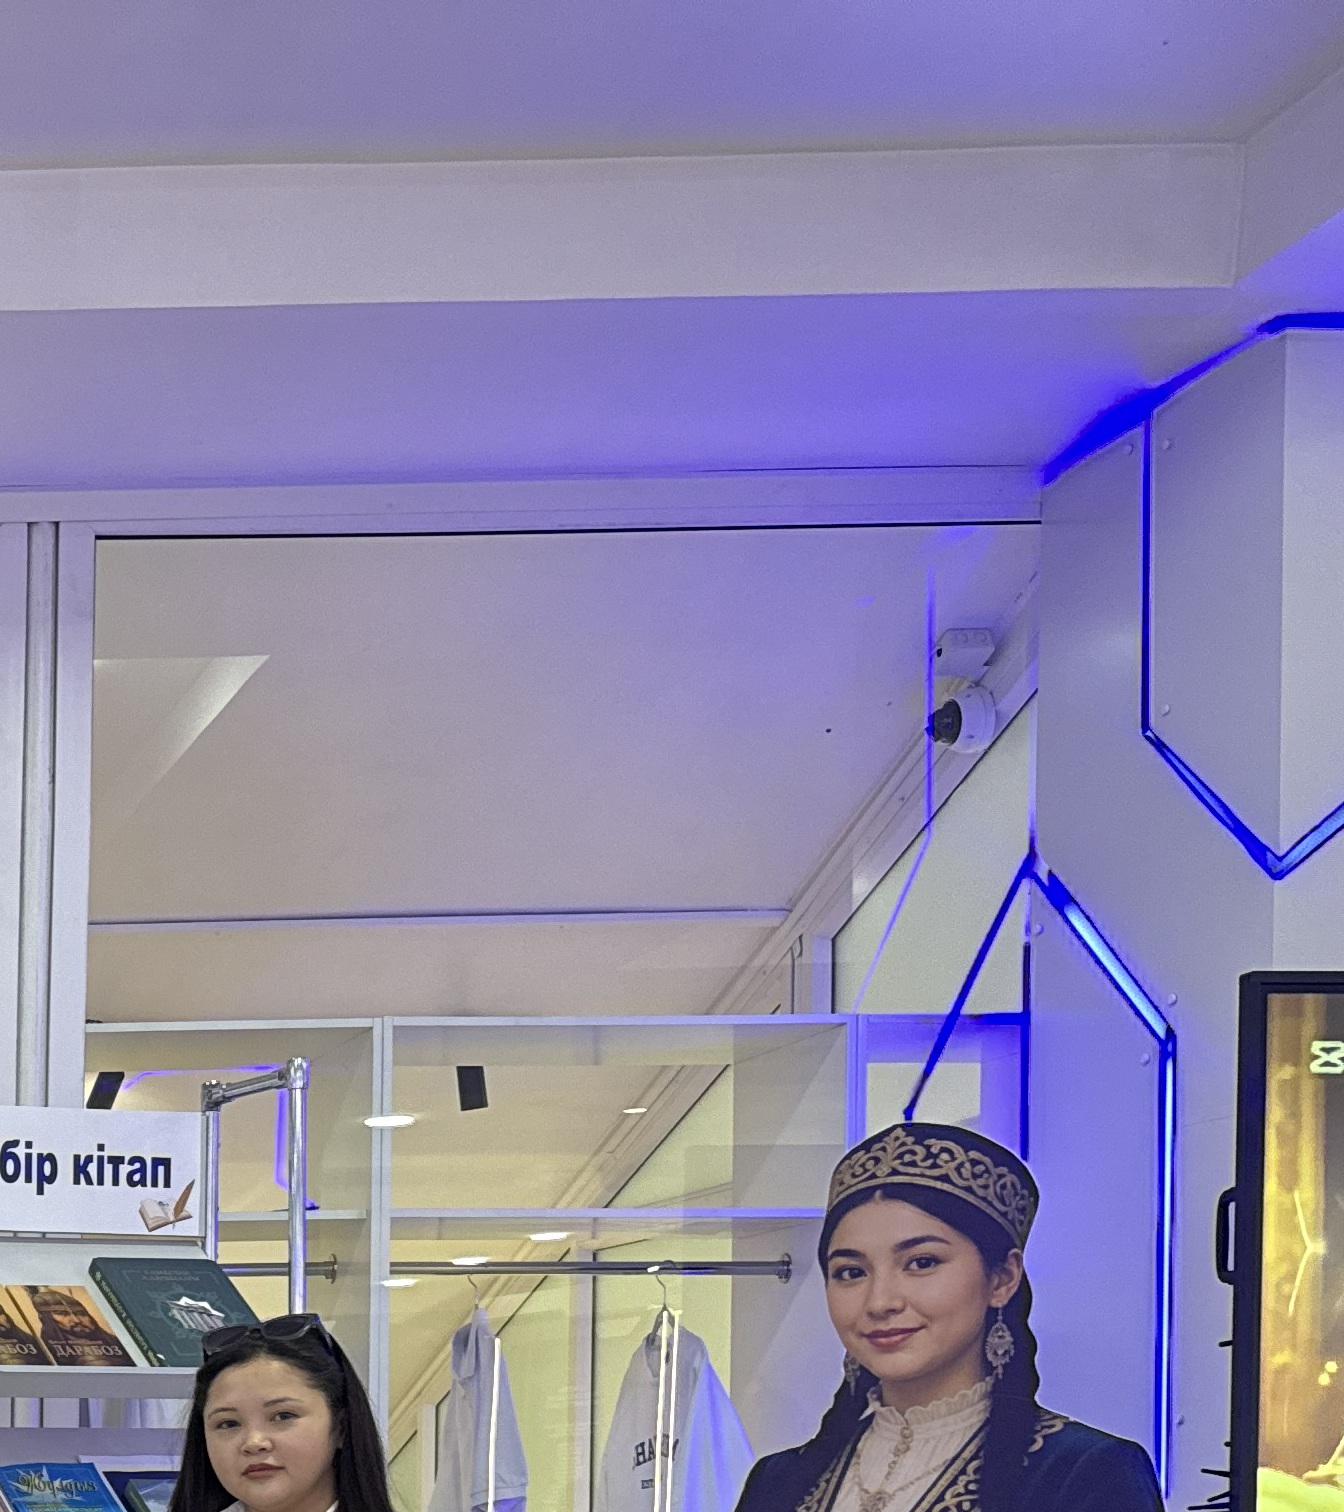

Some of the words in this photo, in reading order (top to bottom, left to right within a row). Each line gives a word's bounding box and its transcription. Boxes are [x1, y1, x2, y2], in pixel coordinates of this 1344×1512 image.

[0, 1139, 58, 1195] бір
[73, 1143, 171, 1189] кітап
[53, 1344, 123, 1357] ДАРАБОЗ
